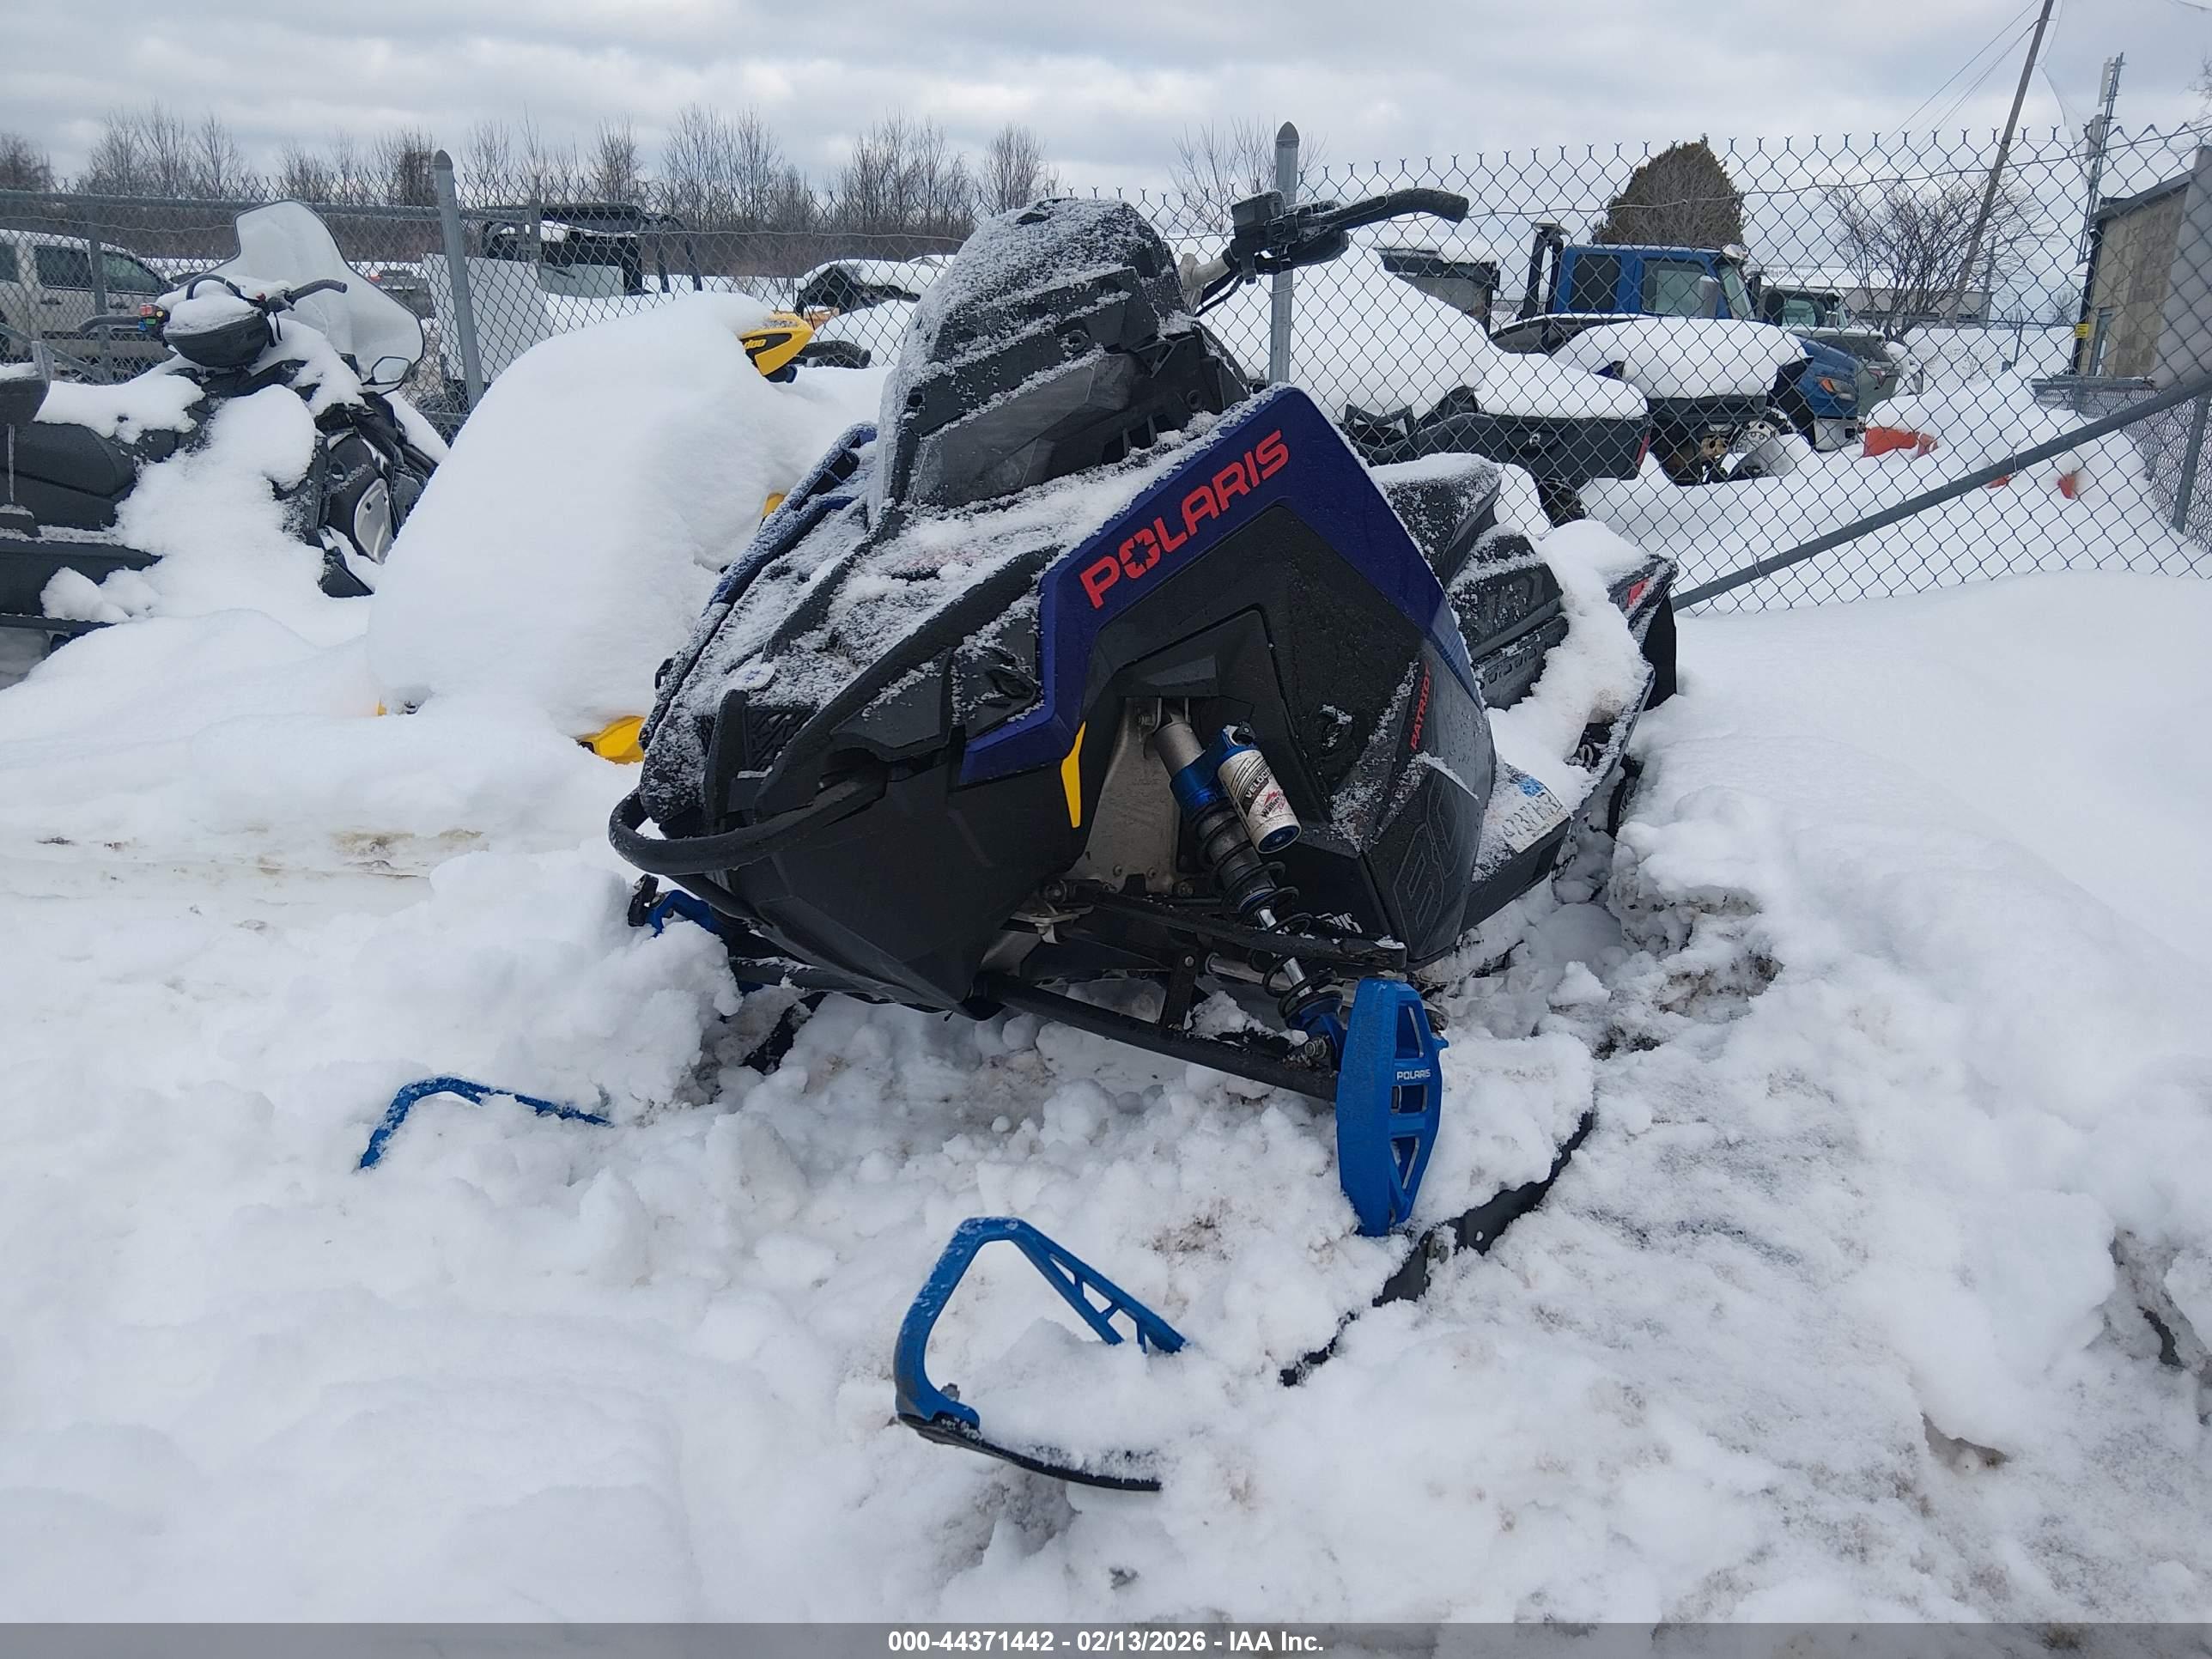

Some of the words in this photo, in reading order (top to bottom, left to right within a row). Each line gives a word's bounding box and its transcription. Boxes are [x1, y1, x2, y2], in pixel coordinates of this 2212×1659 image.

[1079, 429, 1289, 609] POLARIS
[1410, 660, 1431, 750] PATRIOT
[1396, 1068, 1431, 1081] POLARIS
